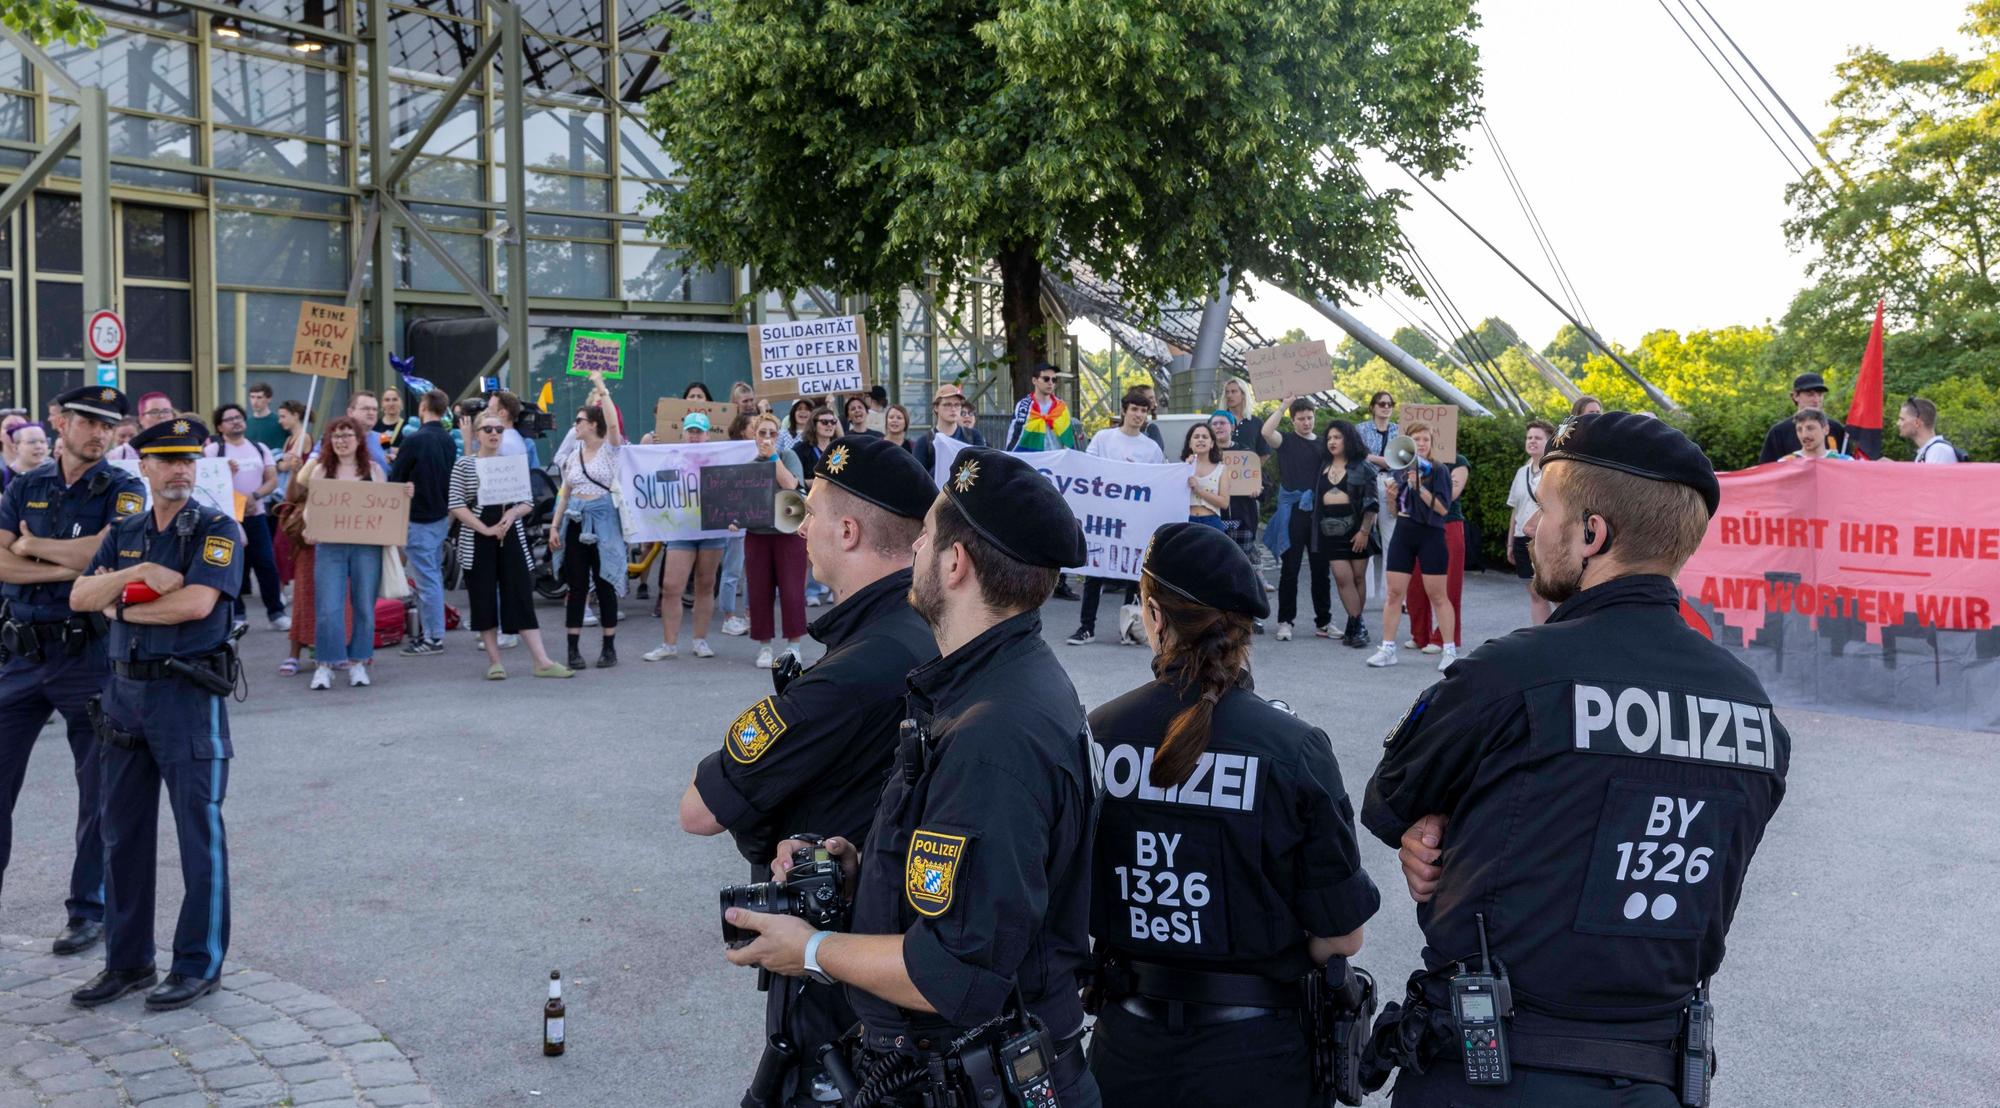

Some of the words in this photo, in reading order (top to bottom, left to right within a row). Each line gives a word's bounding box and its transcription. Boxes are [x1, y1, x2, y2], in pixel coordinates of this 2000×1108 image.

[312, 306, 345, 322] KEINE
[301, 320, 348, 339] SHOW
[763, 318, 853, 340] SOLIDARITÄT
[295, 349, 347, 371] TÄTER!
[764, 345, 789, 360] MIT
[796, 338, 858, 356] OPFERN
[764, 358, 855, 379] SEXUELLER
[802, 376, 860, 393] GEWALT
[1404, 406, 1448, 422] STOP
[1224, 455, 1249, 466] ODY
[1230, 468, 1260, 480] OICE
[311, 489, 353, 509] WIR
[360, 493, 402, 510] SIND
[333, 513, 384, 530] HIER!
[1720, 510, 1829, 549] RÜHRT
[1839, 522, 1899, 555] IHR
[1913, 525, 2000, 560] EINE
[1700, 575, 1905, 628] ANTWORTEN
[1915, 593, 1992, 631] WIR
[756, 702, 780, 736] POLIZEI
[1575, 684, 1775, 770] POLIZEI
[1645, 795, 1706, 839] BY
[914, 839, 959, 858] POLIZEI
[1136, 830, 1182, 868] BY
[1615, 841, 1715, 885] 1326
[1114, 866, 1211, 907] 1326
[1129, 906, 1202, 944] BeSi
